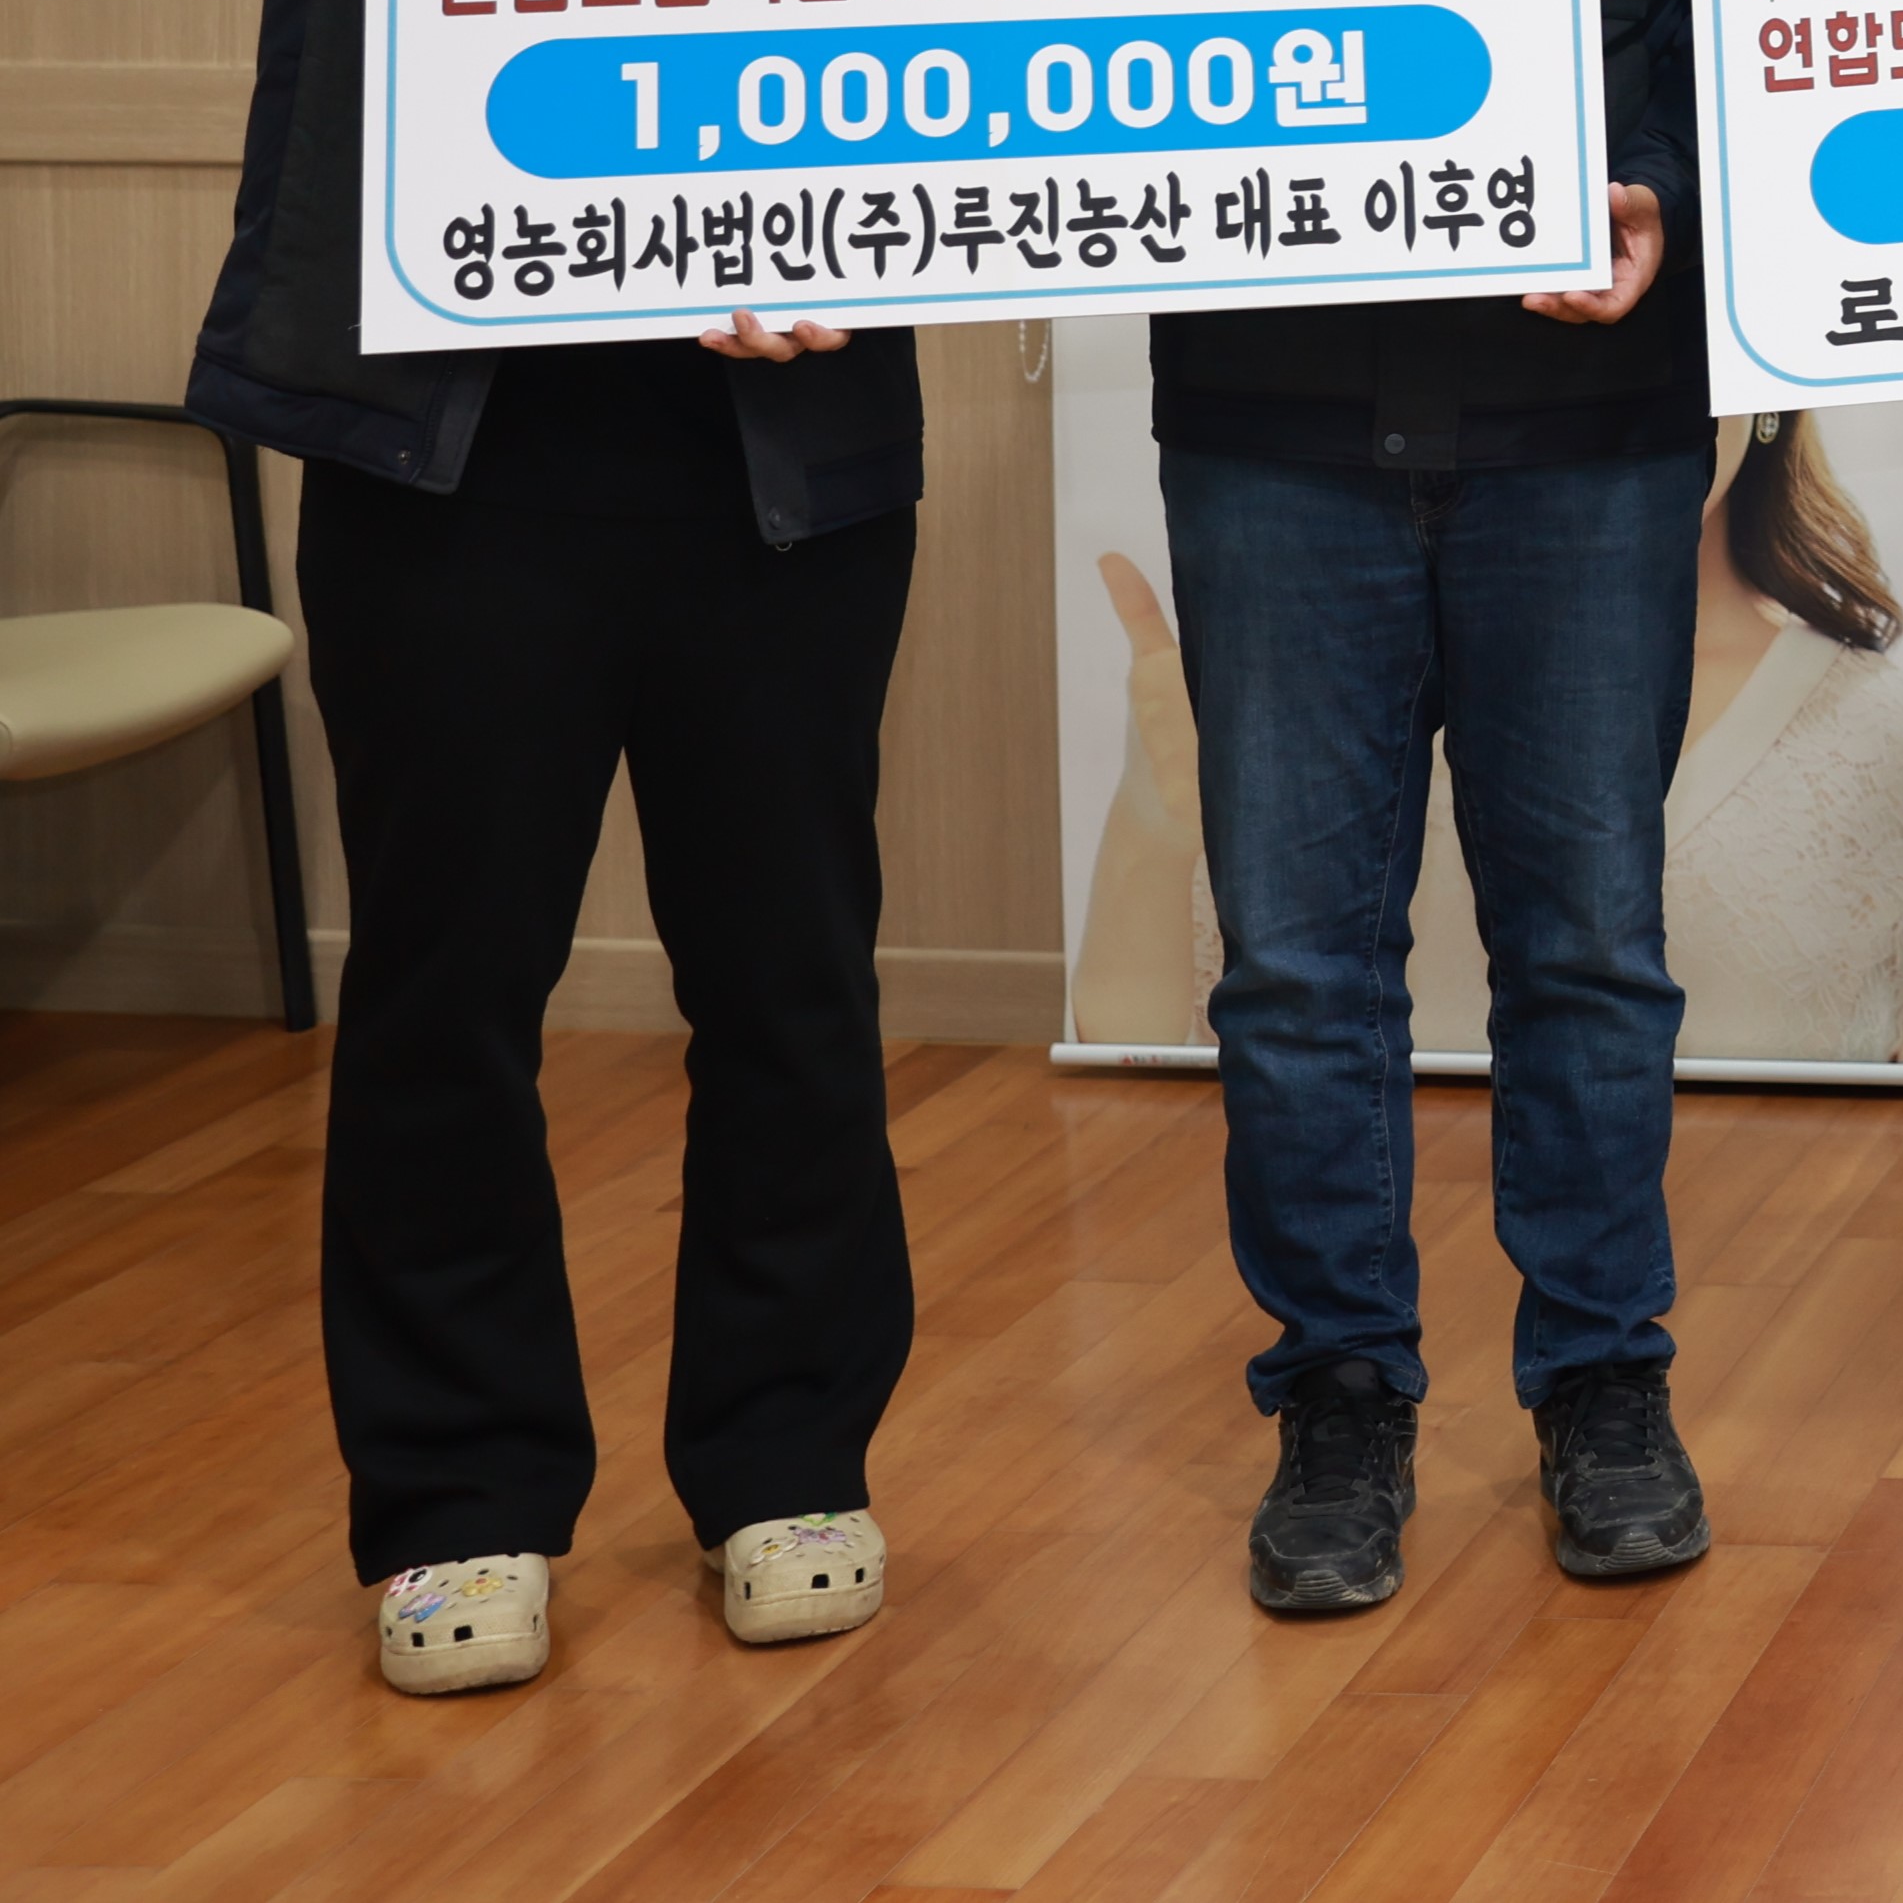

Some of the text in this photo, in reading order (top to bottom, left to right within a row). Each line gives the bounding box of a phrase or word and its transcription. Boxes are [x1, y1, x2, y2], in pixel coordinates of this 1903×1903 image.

[622, 29, 1366, 160] 1,000,000원
[443, 155, 1535, 300] 영농회사법인(주)루진농산 대표 이후영
